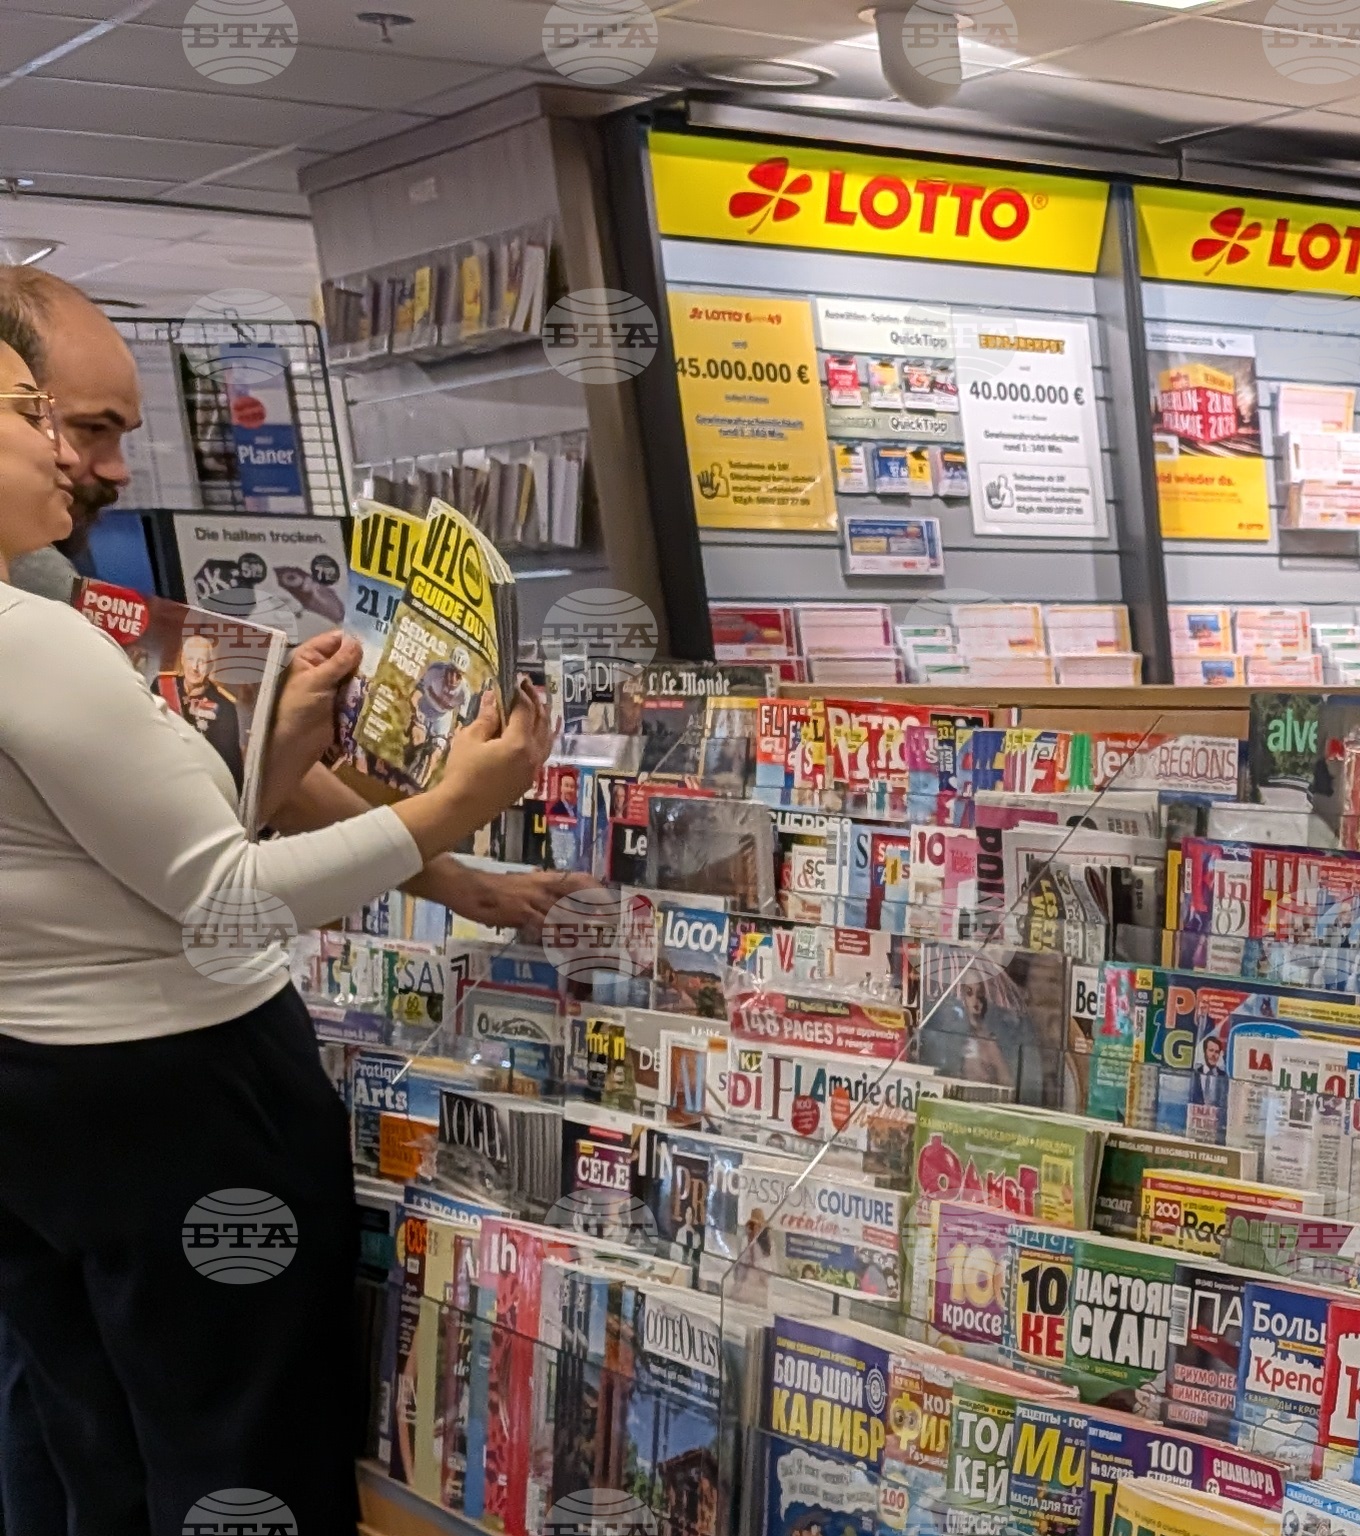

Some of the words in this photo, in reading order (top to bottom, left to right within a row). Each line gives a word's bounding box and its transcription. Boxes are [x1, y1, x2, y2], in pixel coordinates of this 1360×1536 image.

[825, 172, 1031, 242] LOTTO
[890, 331, 947, 349] QuickTipp
[676, 358, 791, 383] 45.000.000
[797, 364, 809, 384] €
[970, 381, 1069, 403] 40.000.000
[1074, 387, 1084, 405] €
[890, 418, 948, 432] QuickTipp
[237, 444, 294, 466] Planer
[195, 528, 219, 542] Die
[222, 528, 266, 542] halten
[84, 590, 144, 621] POINT
[411, 576, 464, 625] GUIDE
[106, 615, 142, 636] VUE
[741, 1005, 780, 1038] 148
[783, 1016, 835, 1047] PAGES
[818, 1189, 894, 1225] COUTURE
[774, 1350, 864, 1409] БОЛЬШОЙ
[772, 1392, 885, 1463] КАЛИБР
[1146, 1439, 1193, 1475] 100
[1213, 1458, 1275, 1495] СКАНВОРД
